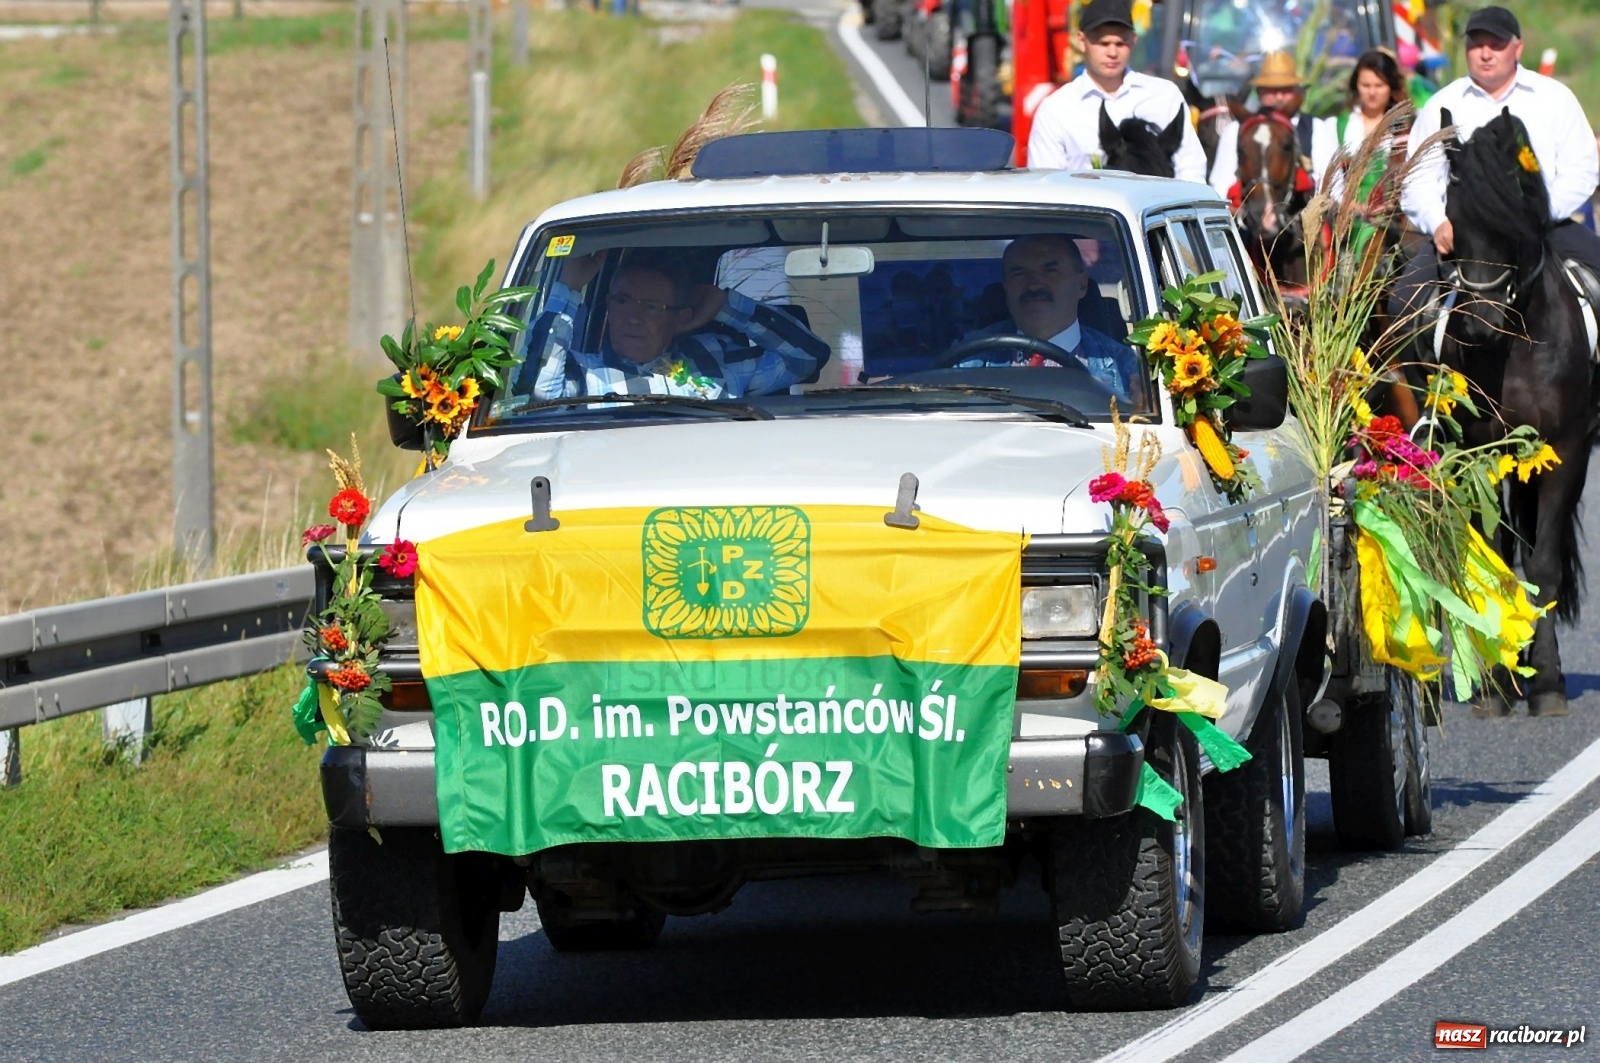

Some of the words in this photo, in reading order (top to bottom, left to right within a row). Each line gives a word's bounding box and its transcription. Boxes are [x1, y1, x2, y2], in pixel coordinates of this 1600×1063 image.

[592, 693, 654, 738] im.
[667, 683, 914, 736] Powstańców
[918, 679, 966, 742] Śl.
[601, 743, 855, 817] RACIBÓRZ
